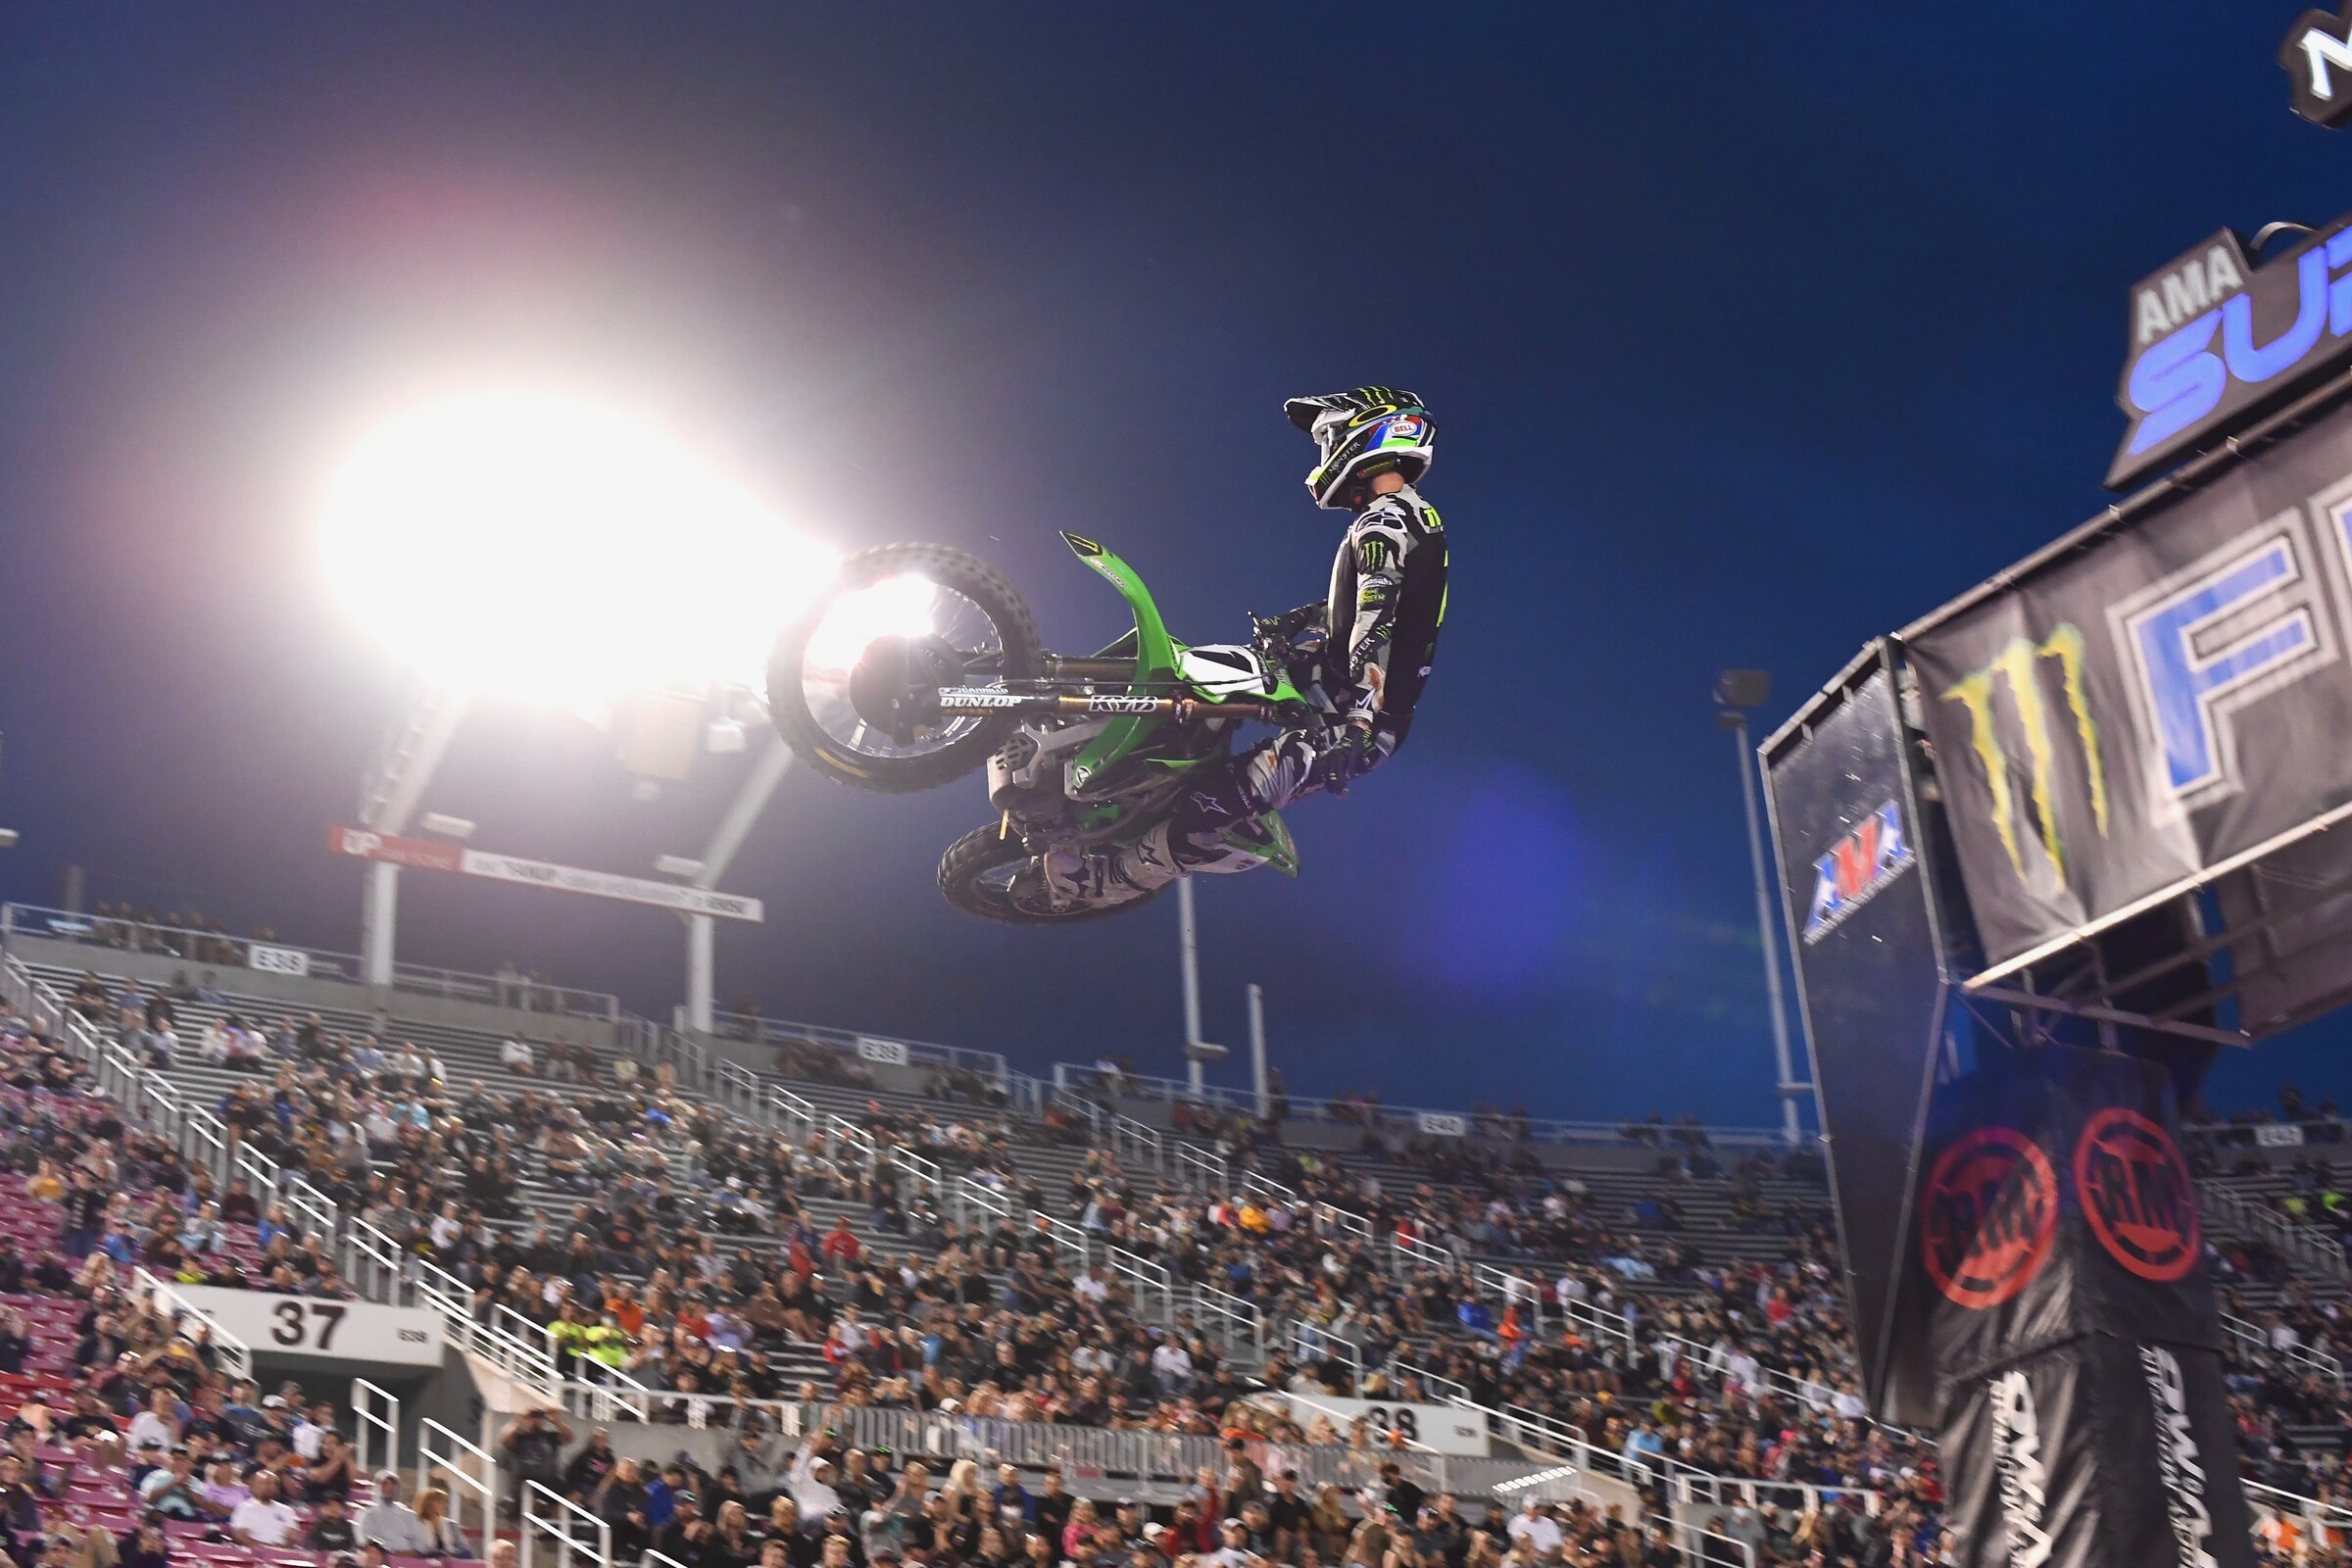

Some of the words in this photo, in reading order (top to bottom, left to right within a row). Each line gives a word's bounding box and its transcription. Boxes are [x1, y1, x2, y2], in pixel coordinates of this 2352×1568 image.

[2136, 245, 2244, 345] AMA
[1394, 424, 1413, 433] BELL
[940, 697, 1022, 708] DUNLOP
[271, 1299, 348, 1350] 37
